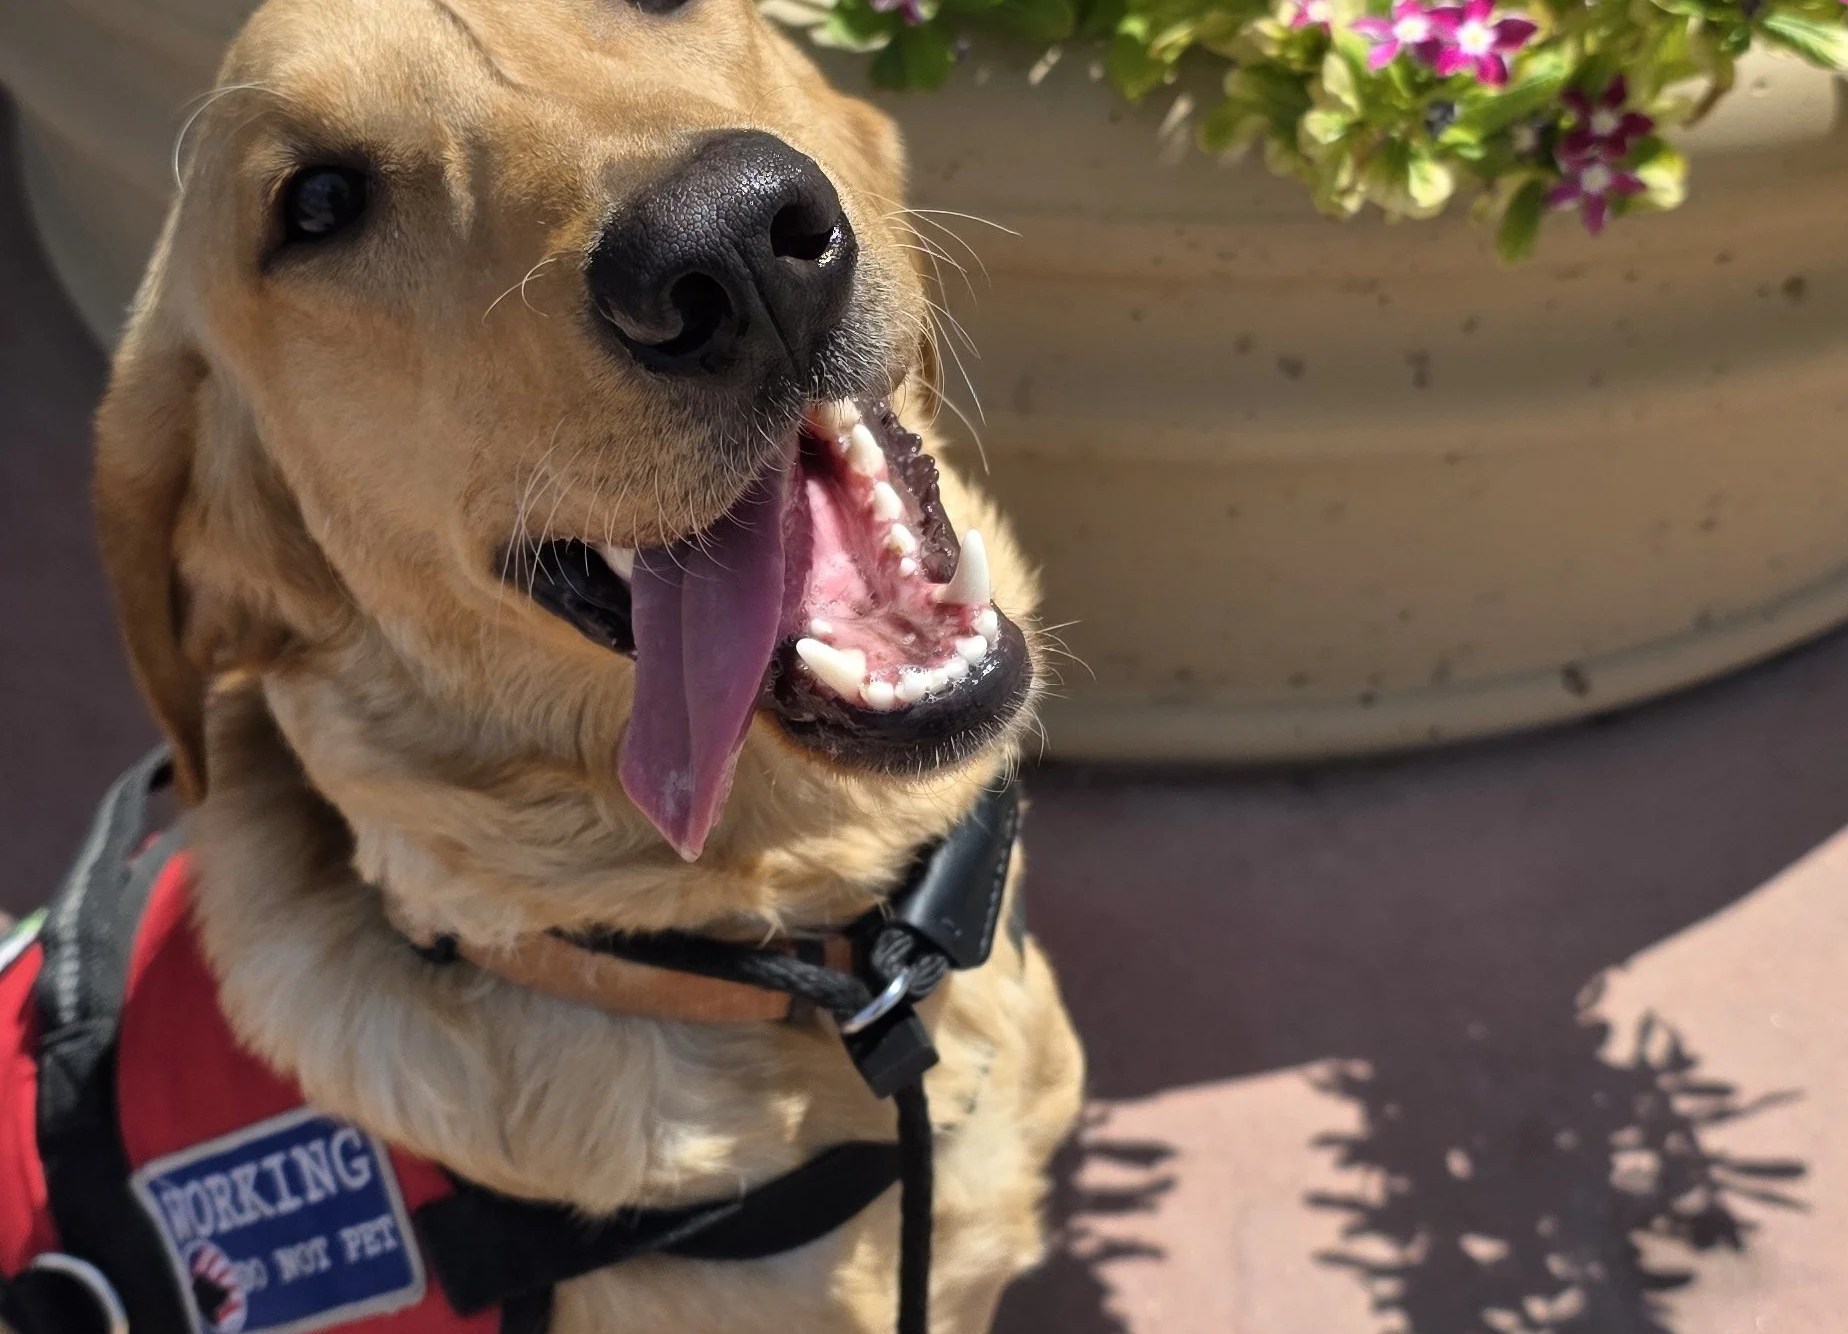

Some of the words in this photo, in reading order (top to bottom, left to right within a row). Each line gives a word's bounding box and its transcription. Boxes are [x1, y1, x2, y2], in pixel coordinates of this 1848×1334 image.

[159, 1126, 372, 1242] WORKING
[272, 1236, 332, 1284] NOT
[339, 1214, 398, 1264] PET
